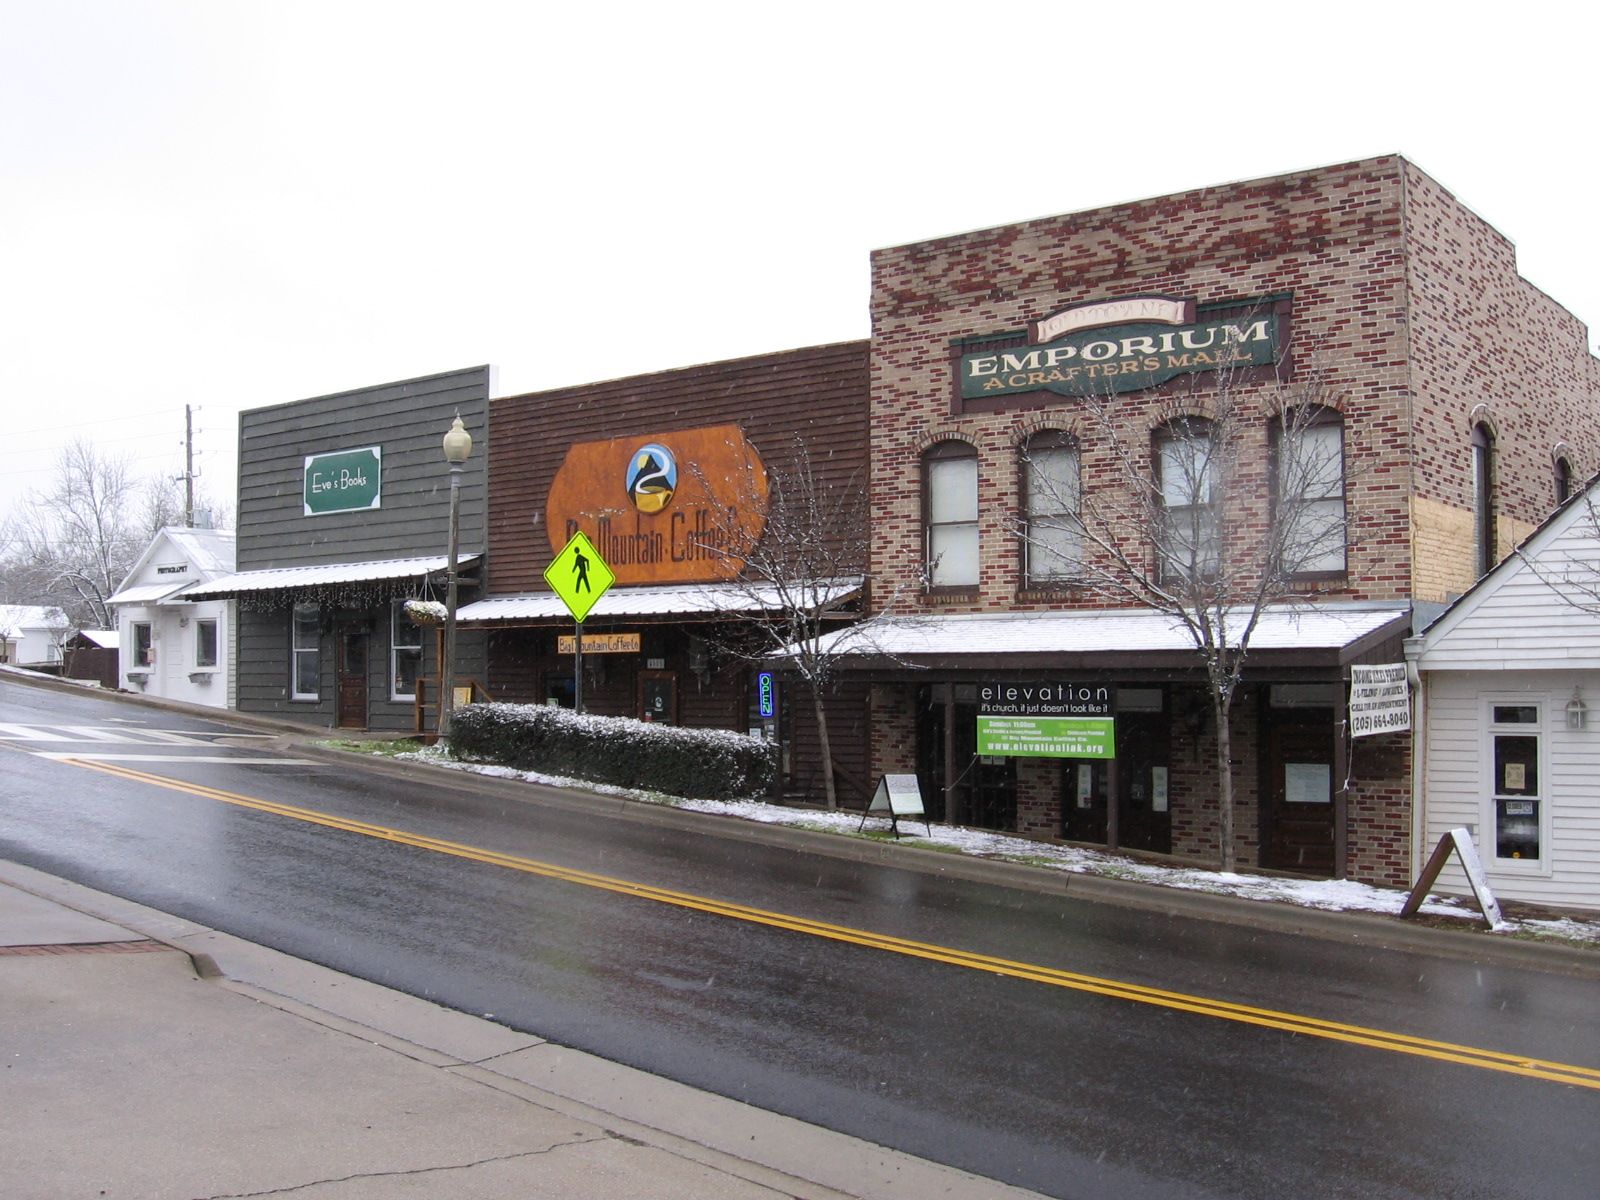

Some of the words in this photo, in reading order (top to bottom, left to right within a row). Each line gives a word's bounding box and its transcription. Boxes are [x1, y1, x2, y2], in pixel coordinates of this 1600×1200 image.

[968, 320, 1270, 378] EMPORIUM
[983, 377, 1005, 391] A
[1004, 355, 1160, 388] CRAFTER'S
[312, 470, 338, 494] Eve's
[340, 466, 367, 490] Books
[761, 675, 771, 714] OPEN
[981, 684, 1108, 700] elevation
[981, 703, 991, 712] it's
[1020, 703, 1026, 712] it
[1026, 703, 1040, 714] just
[1041, 703, 1069, 713] doesn't
[1070, 703, 1088, 713] look
[1088, 703, 1102, 713] like
[1103, 703, 1108, 713] it
[1352, 716, 1372, 734] (205)
[1373, 711, 1409, 729] 664-8040
